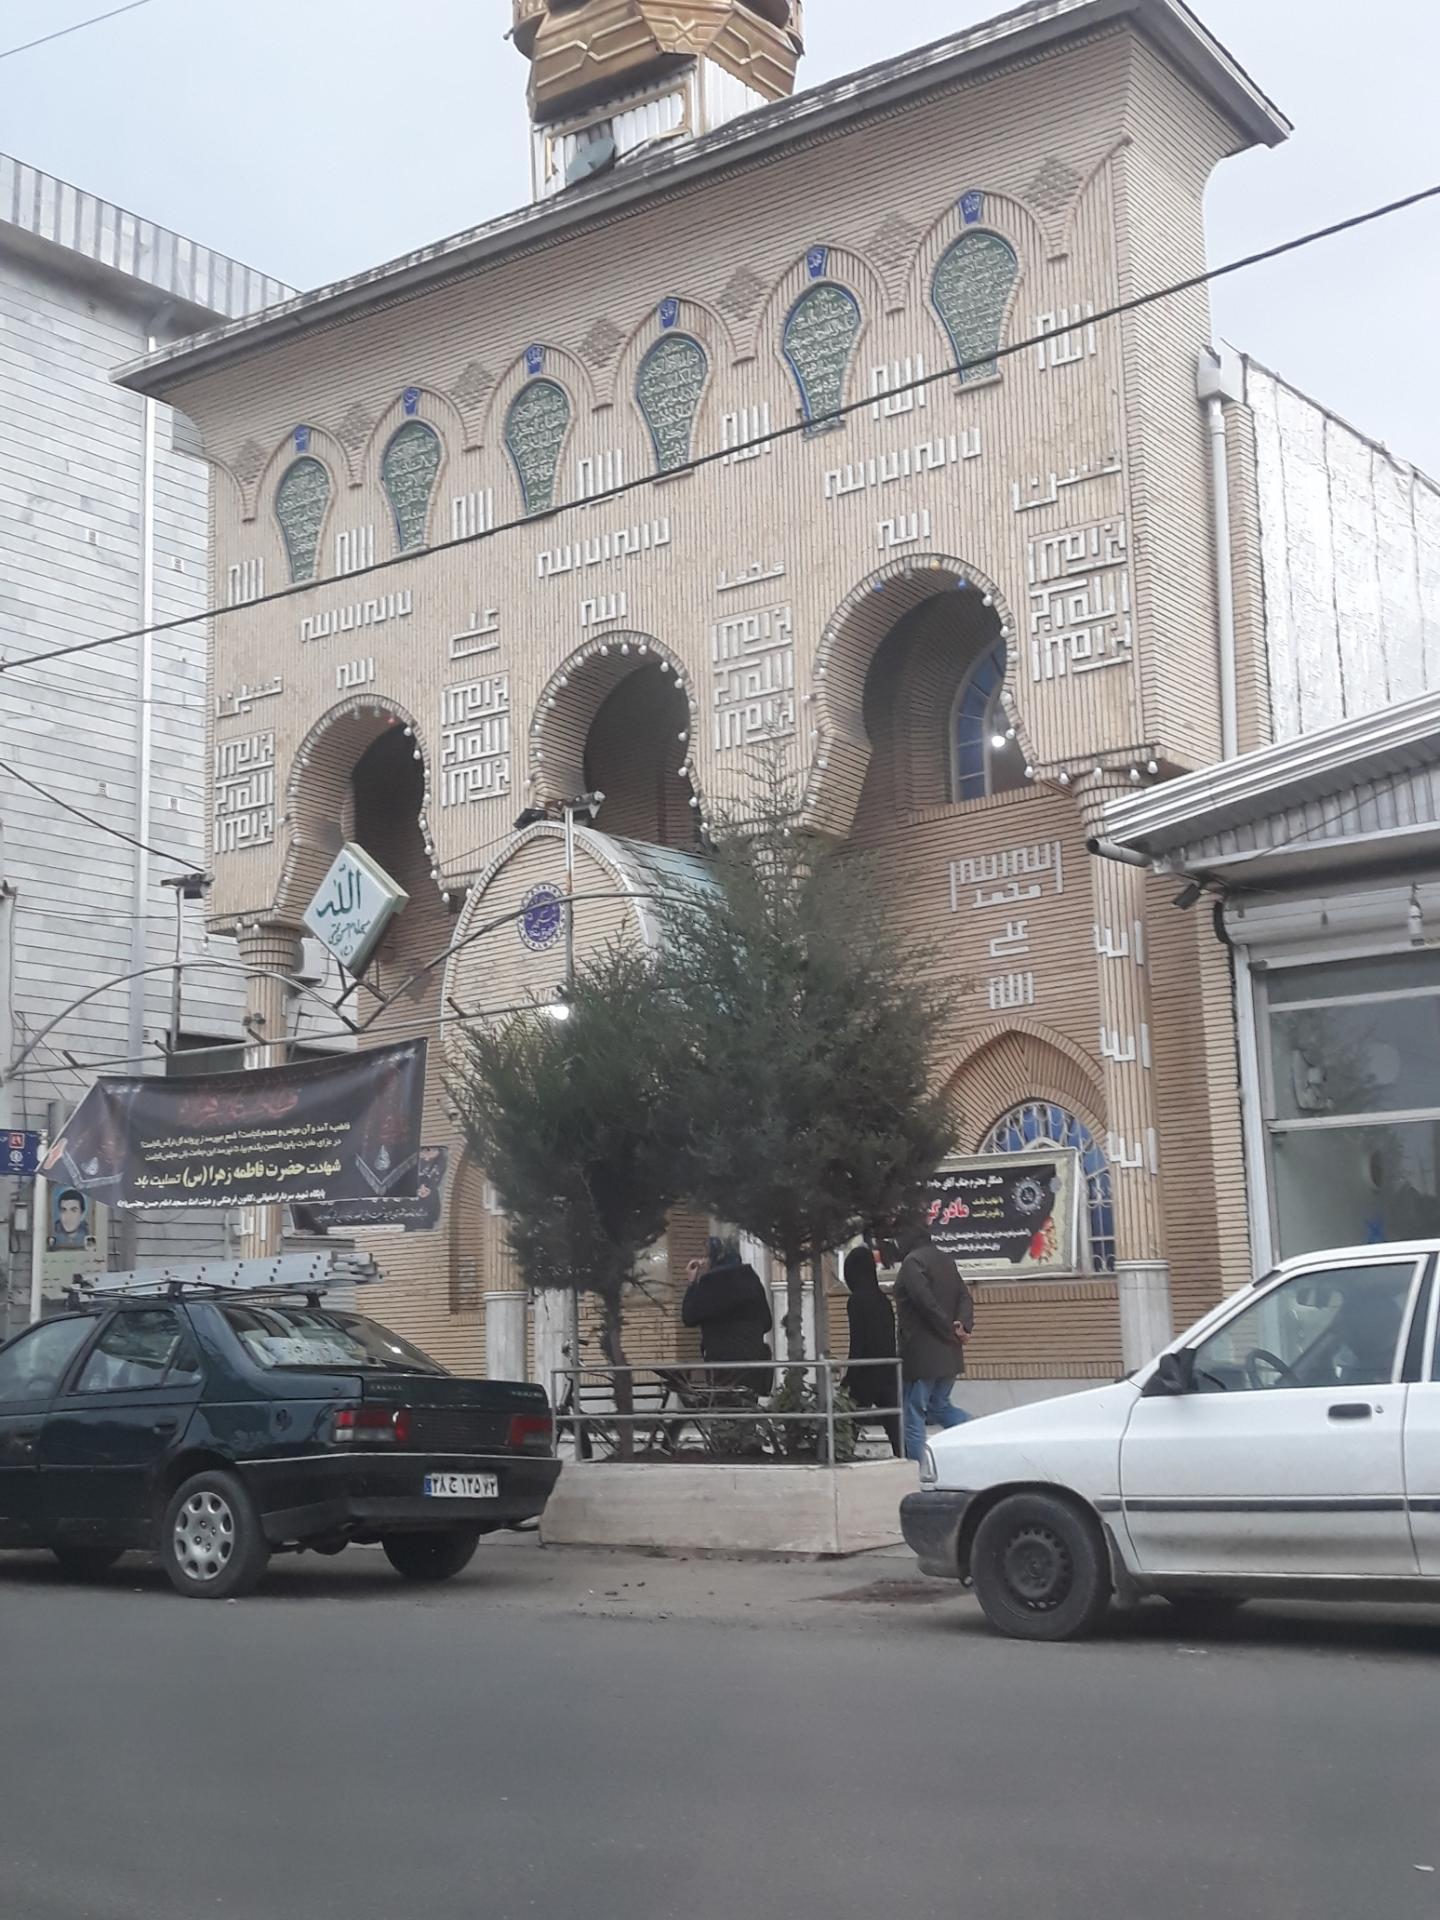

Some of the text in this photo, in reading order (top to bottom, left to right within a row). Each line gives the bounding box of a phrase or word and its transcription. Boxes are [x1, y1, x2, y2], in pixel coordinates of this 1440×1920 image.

[316, 864, 361, 918] الله
[208, 1165, 232, 1186] زهرا
[233, 1160, 264, 1180] فاطمه
[265, 1159, 305, 1181] حضرت
[306, 1158, 342, 1176] شهادت
[134, 1175, 149, 1188] باد
[150, 1172, 182, 1189] تسلیت
[939, 1196, 970, 1225] مادر
